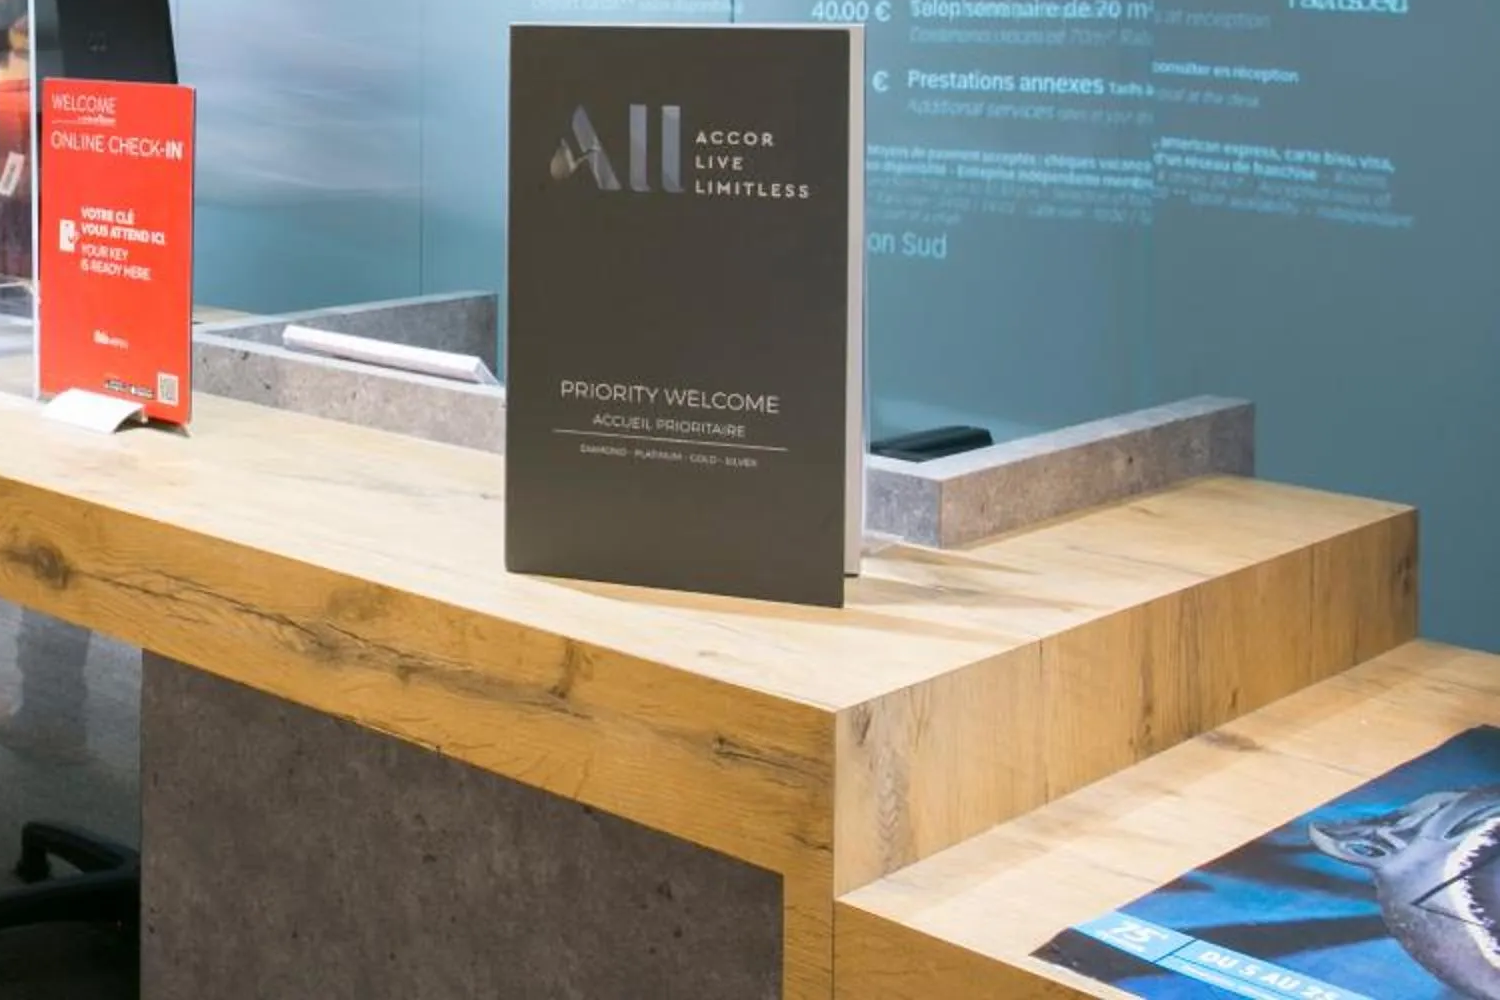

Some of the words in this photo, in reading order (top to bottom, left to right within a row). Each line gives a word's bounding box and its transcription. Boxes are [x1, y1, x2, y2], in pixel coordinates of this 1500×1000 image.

[811, 0, 871, 23] 40.00
[873, 0, 893, 22] €
[871, 70, 891, 93] €
[907, 69, 1015, 92] Prestations
[1018, 74, 1106, 96] annexes
[51, 93, 117, 115] WELCOME
[51, 130, 106, 153] ONLINE
[107, 135, 185, 161] CHECK-IN
[695, 130, 775, 148] ACCOR
[695, 155, 744, 171] LIVE
[694, 180, 811, 200] LIMITLESS
[901, 230, 948, 259] Sud
[560, 379, 659, 404] PRIORITY
[663, 388, 781, 415] WELCOME
[592, 413, 654, 432] ACCUEIL
[655, 418, 747, 438] PRIORITAIRE
[689, 453, 717, 465] GOLD
[1198, 950, 1238, 969] DU
[1260, 972, 1301, 991] AU
